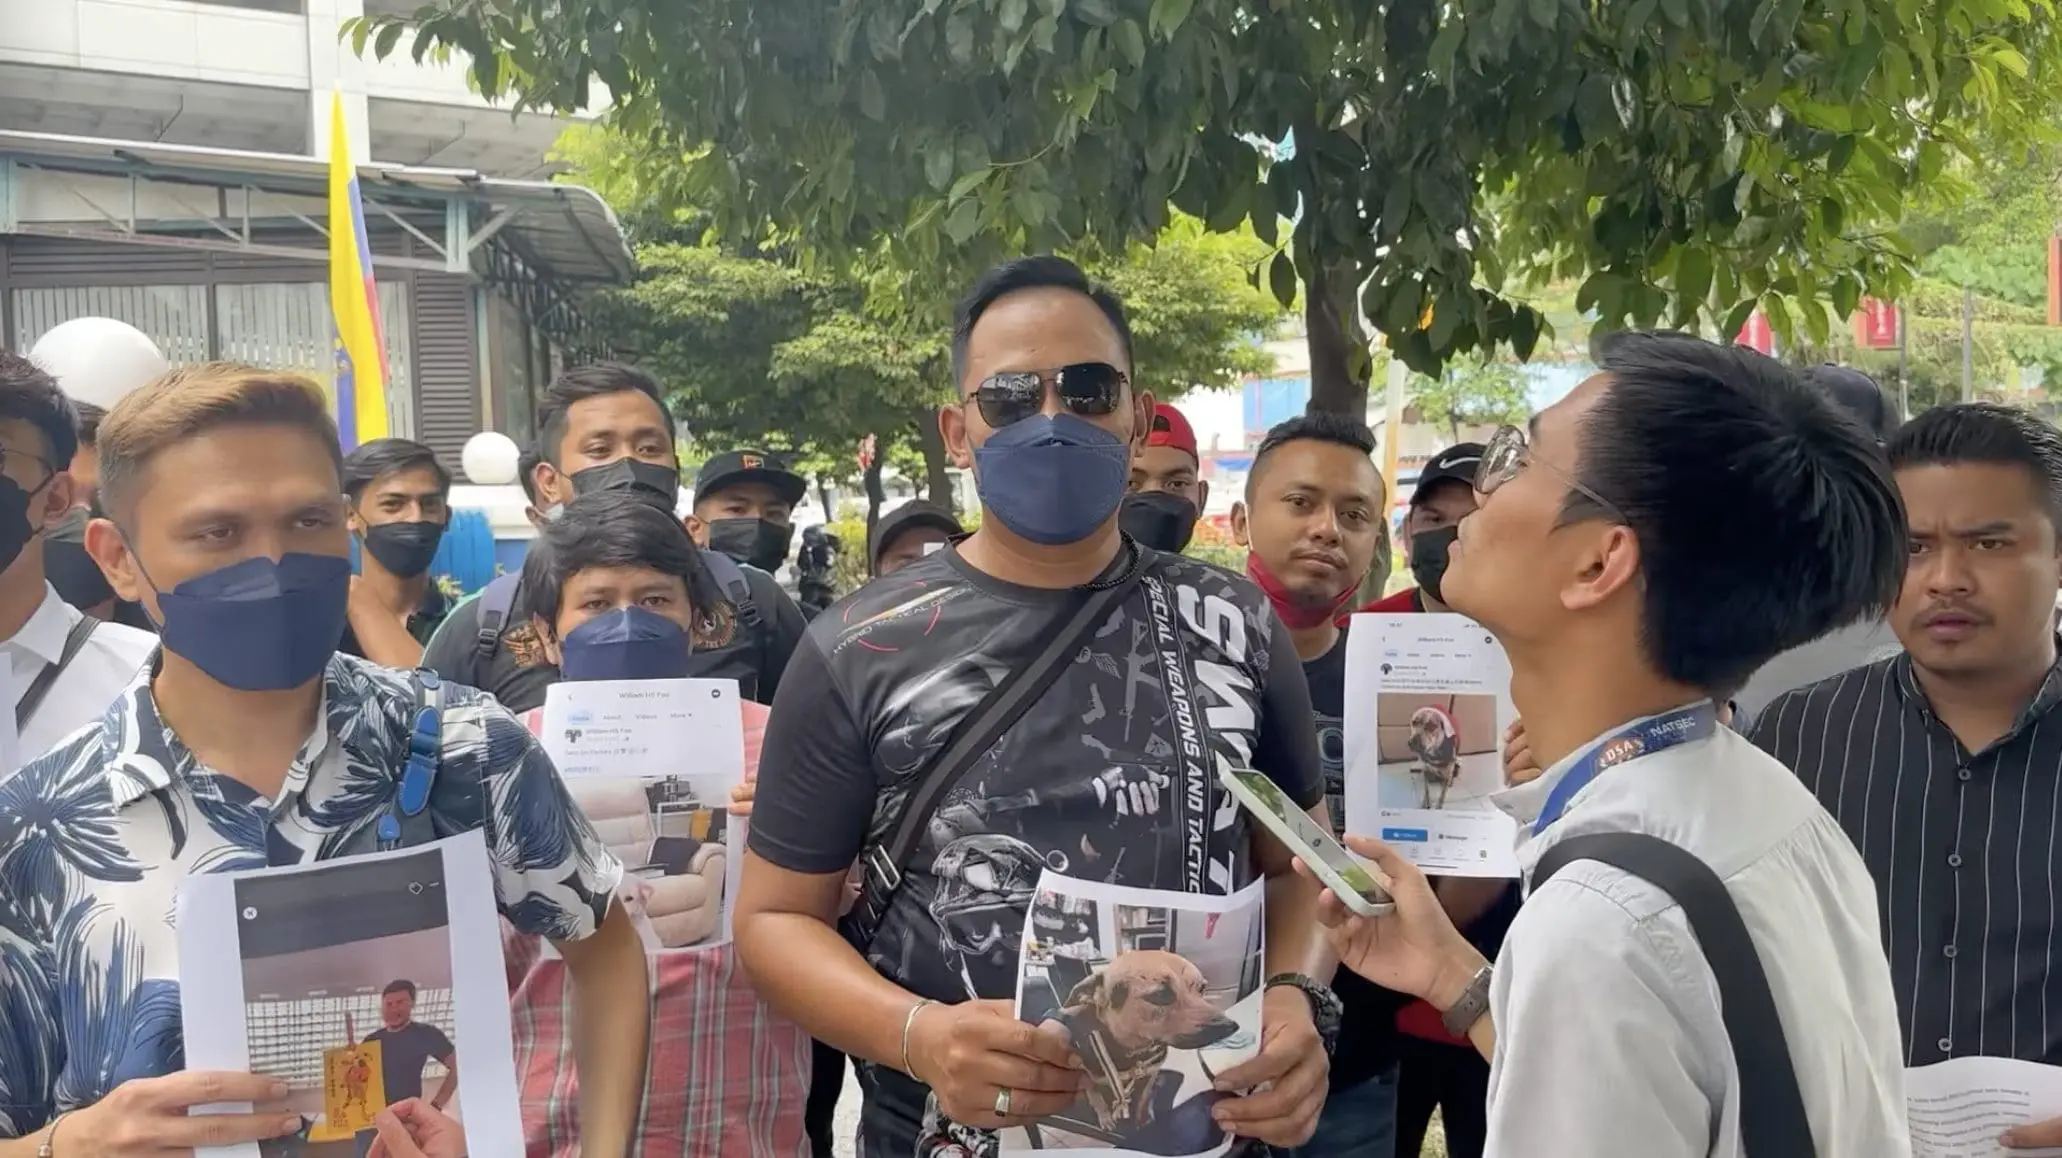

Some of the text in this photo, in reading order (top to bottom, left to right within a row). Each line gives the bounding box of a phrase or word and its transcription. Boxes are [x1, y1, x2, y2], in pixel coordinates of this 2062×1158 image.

[1161, 650, 1201, 758] WEAPONS
[1186, 760, 1204, 812] AND
[1650, 716, 1696, 737] NATSEC
[1606, 740, 1634, 761] DSA
